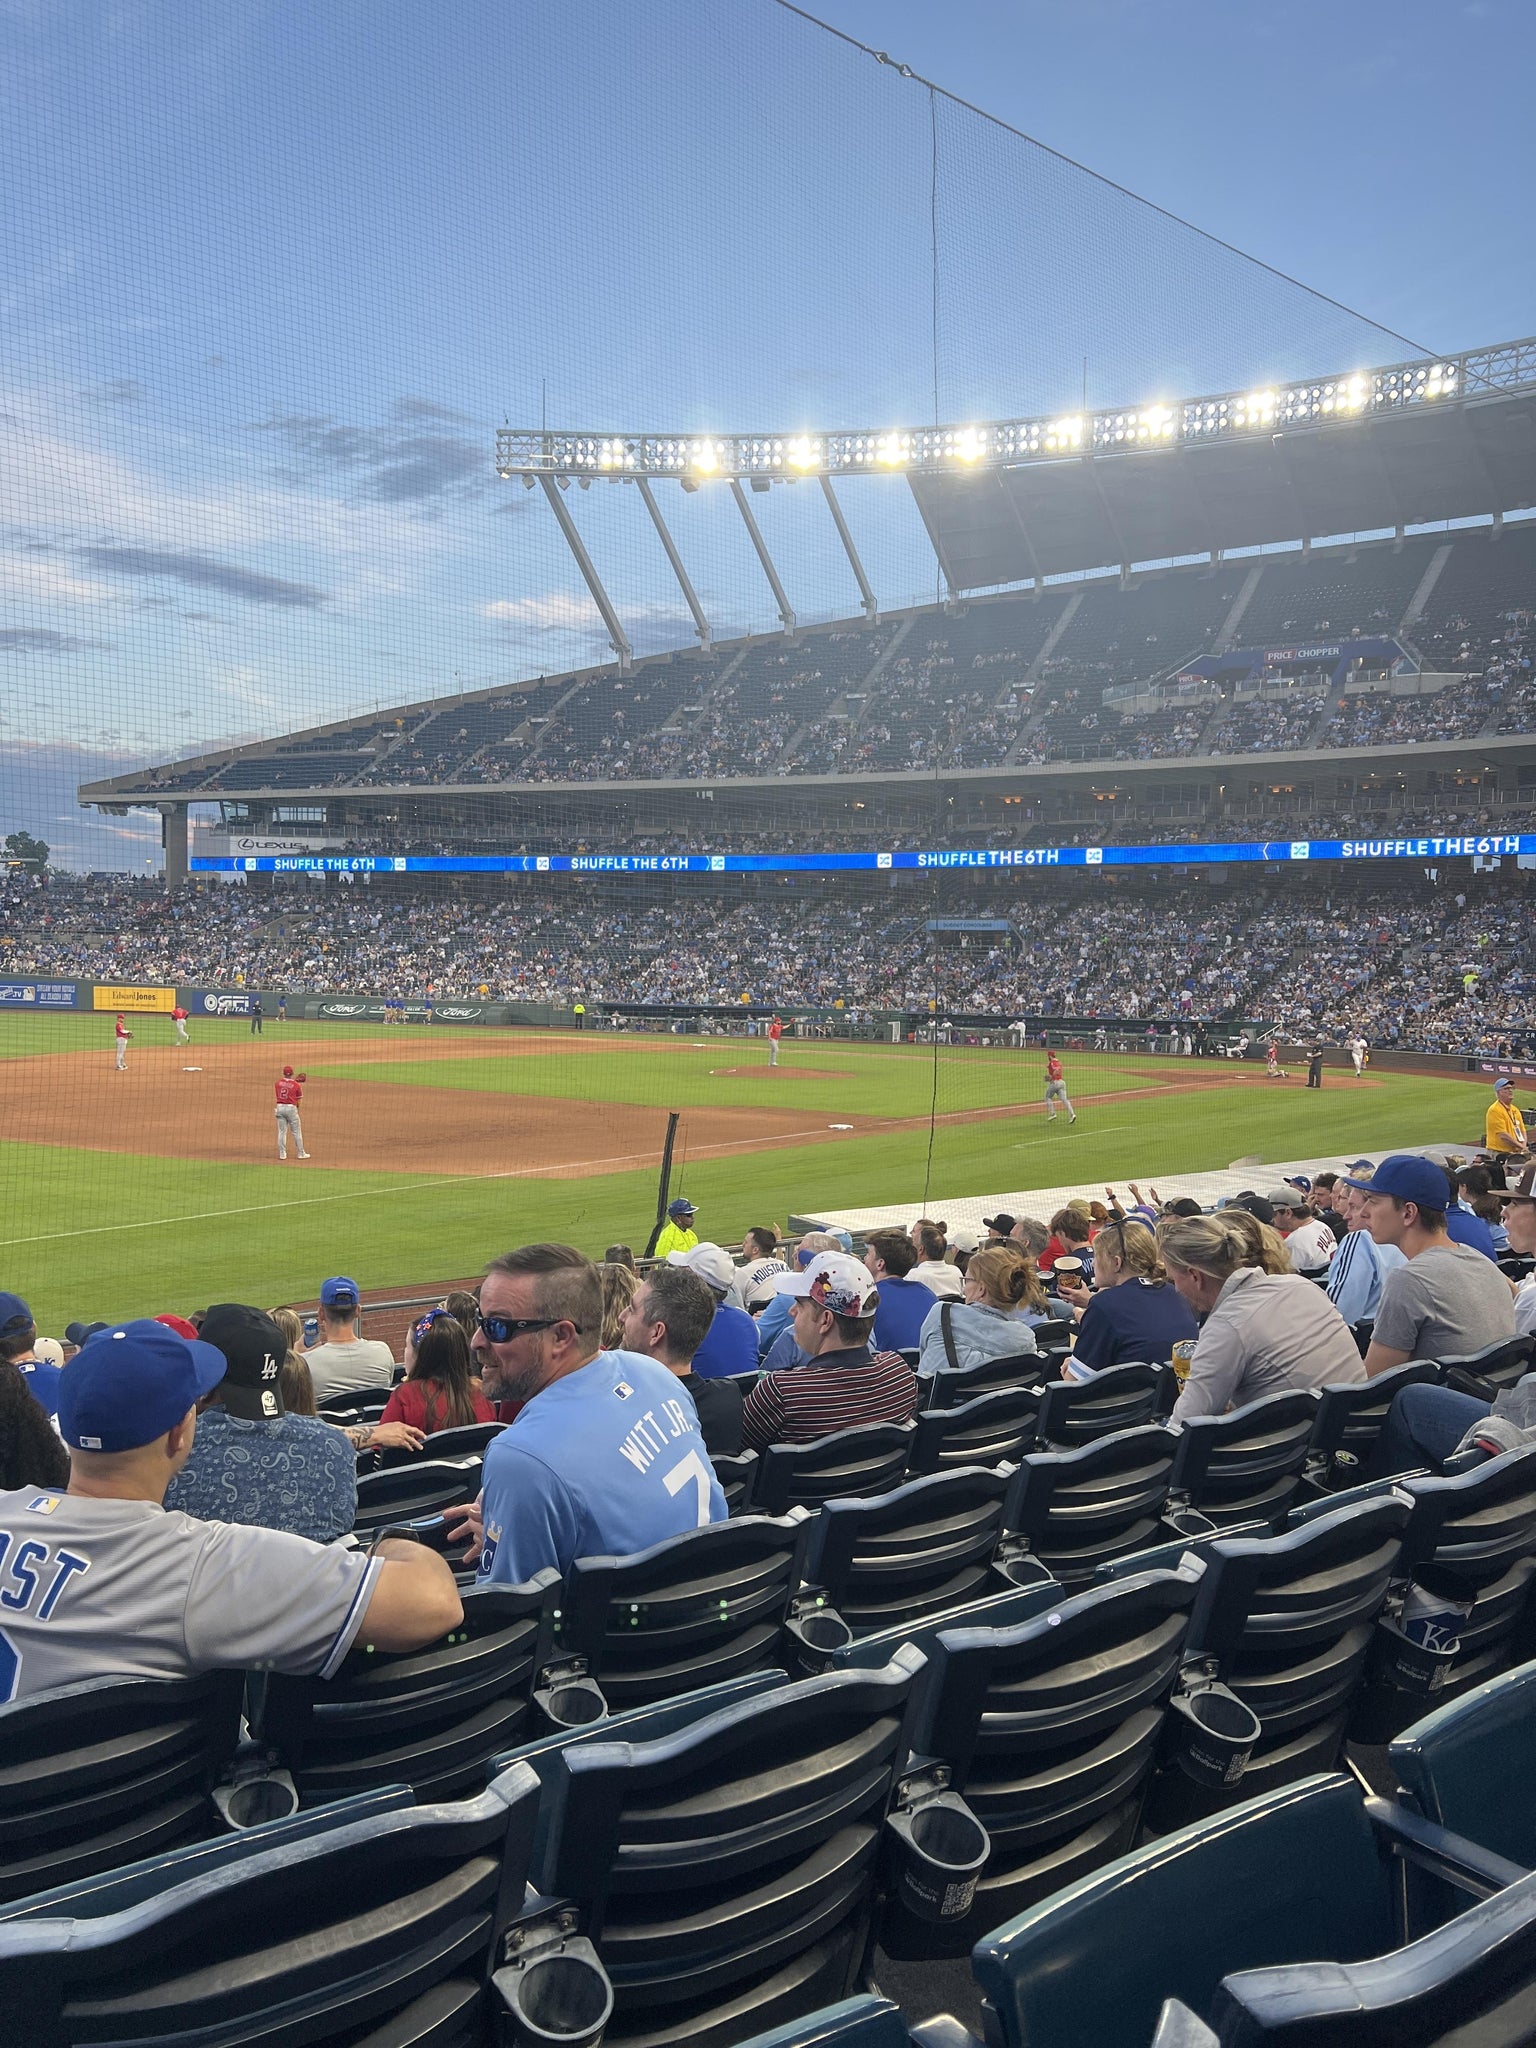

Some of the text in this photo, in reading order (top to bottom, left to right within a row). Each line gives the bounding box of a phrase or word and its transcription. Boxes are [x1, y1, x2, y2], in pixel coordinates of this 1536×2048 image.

[1267, 647, 1339, 661] PRICE CHOPPER
[256, 842, 303, 850] LEXUS
[1342, 836, 1520, 857] SHUFFLE THE 6TH
[274, 858, 375, 870] SHUFFLE THE 6TH
[571, 857, 689, 870] SHUFFLE THE 6TH
[918, 849, 1059, 866] SHUFFLE THE 6TH
[112, 991, 156, 1001] Edward Jones
[329, 1004, 357, 1014] Ford
[443, 1007, 472, 1016] Ford
[261, 1353, 278, 1380] LA
[618, 1398, 694, 1475] WITT JR.
[662, 1448, 711, 1528] 7
